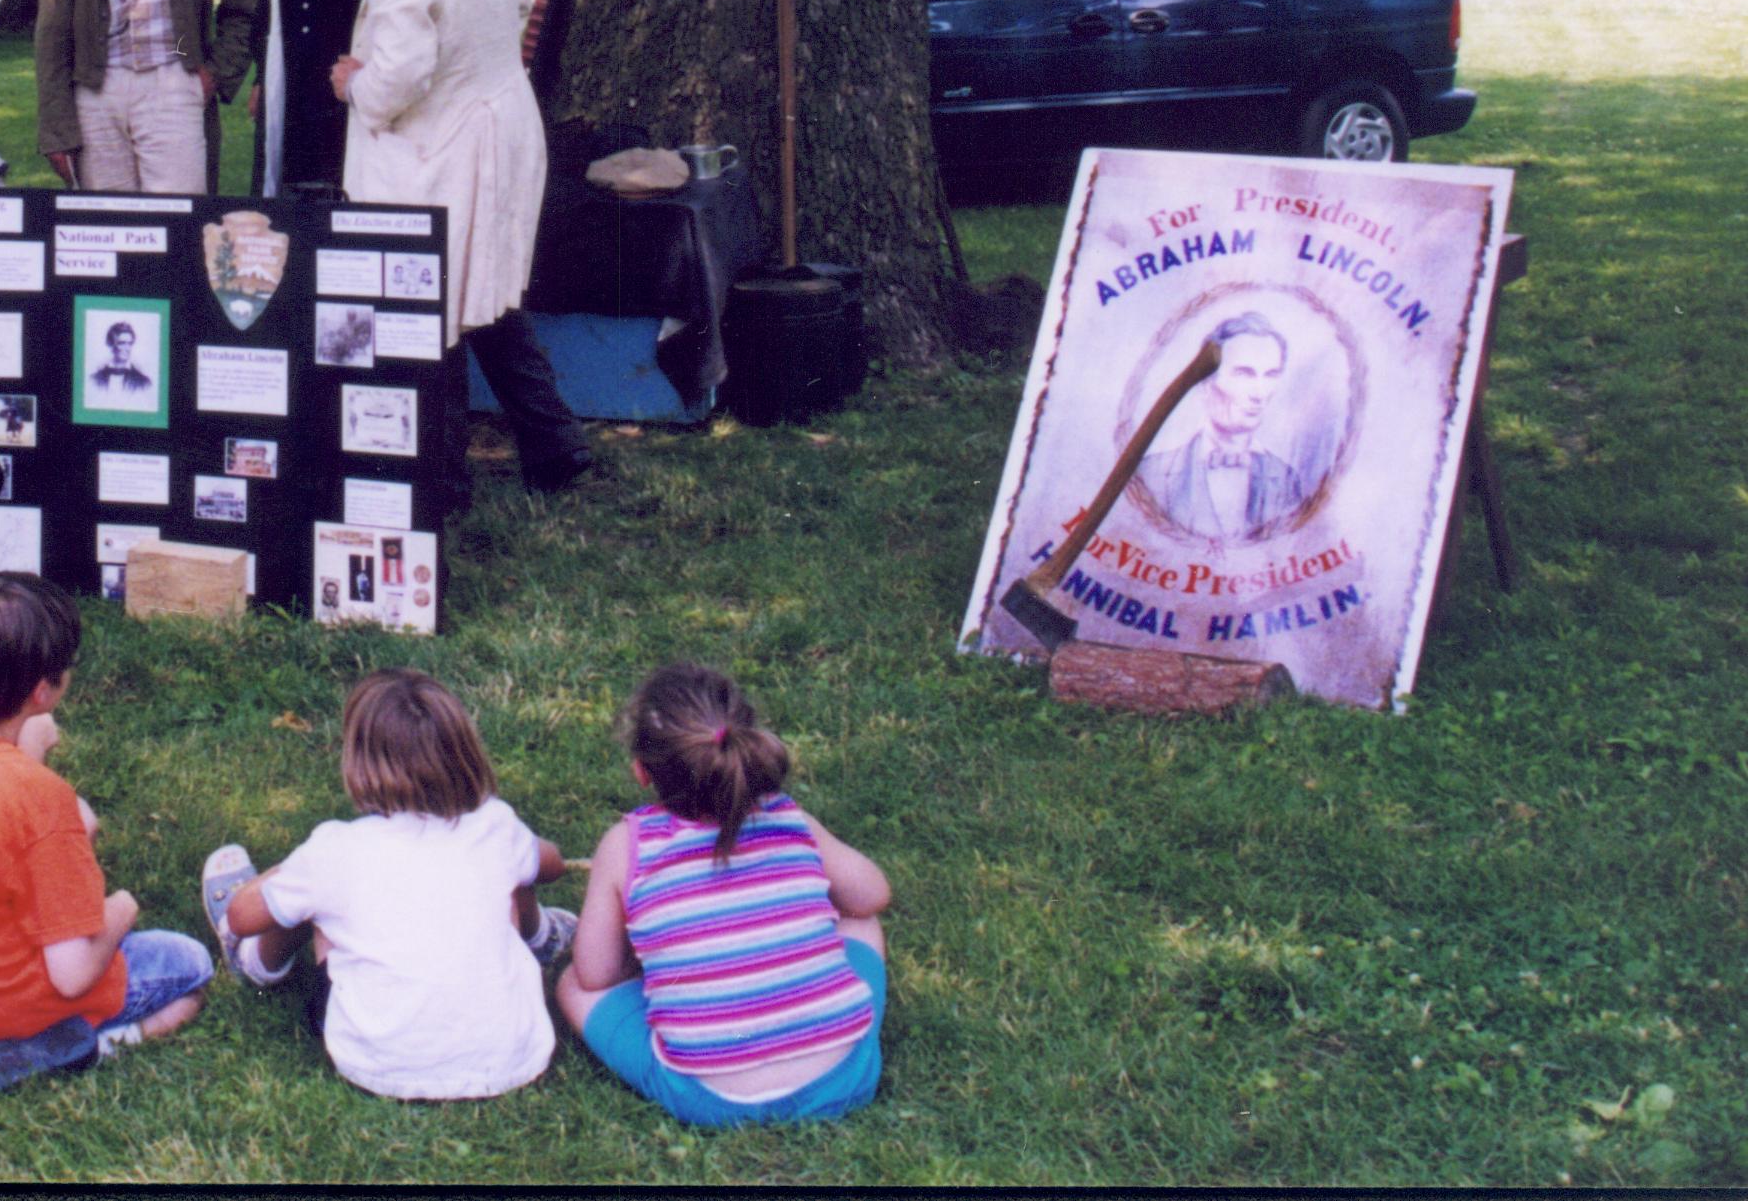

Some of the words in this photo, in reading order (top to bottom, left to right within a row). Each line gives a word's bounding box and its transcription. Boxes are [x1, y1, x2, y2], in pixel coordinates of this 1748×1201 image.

[58, 230, 114, 243] National
[125, 231, 157, 245] Park
[1147, 203, 1201, 238] For
[57, 256, 105, 269] Service
[1095, 229, 1255, 307] ABRAHAM
[1297, 234, 1431, 337] LINCOLN.
[1117, 538, 1178, 590] Vice
[1030, 540, 1179, 639] HNNIBAL
